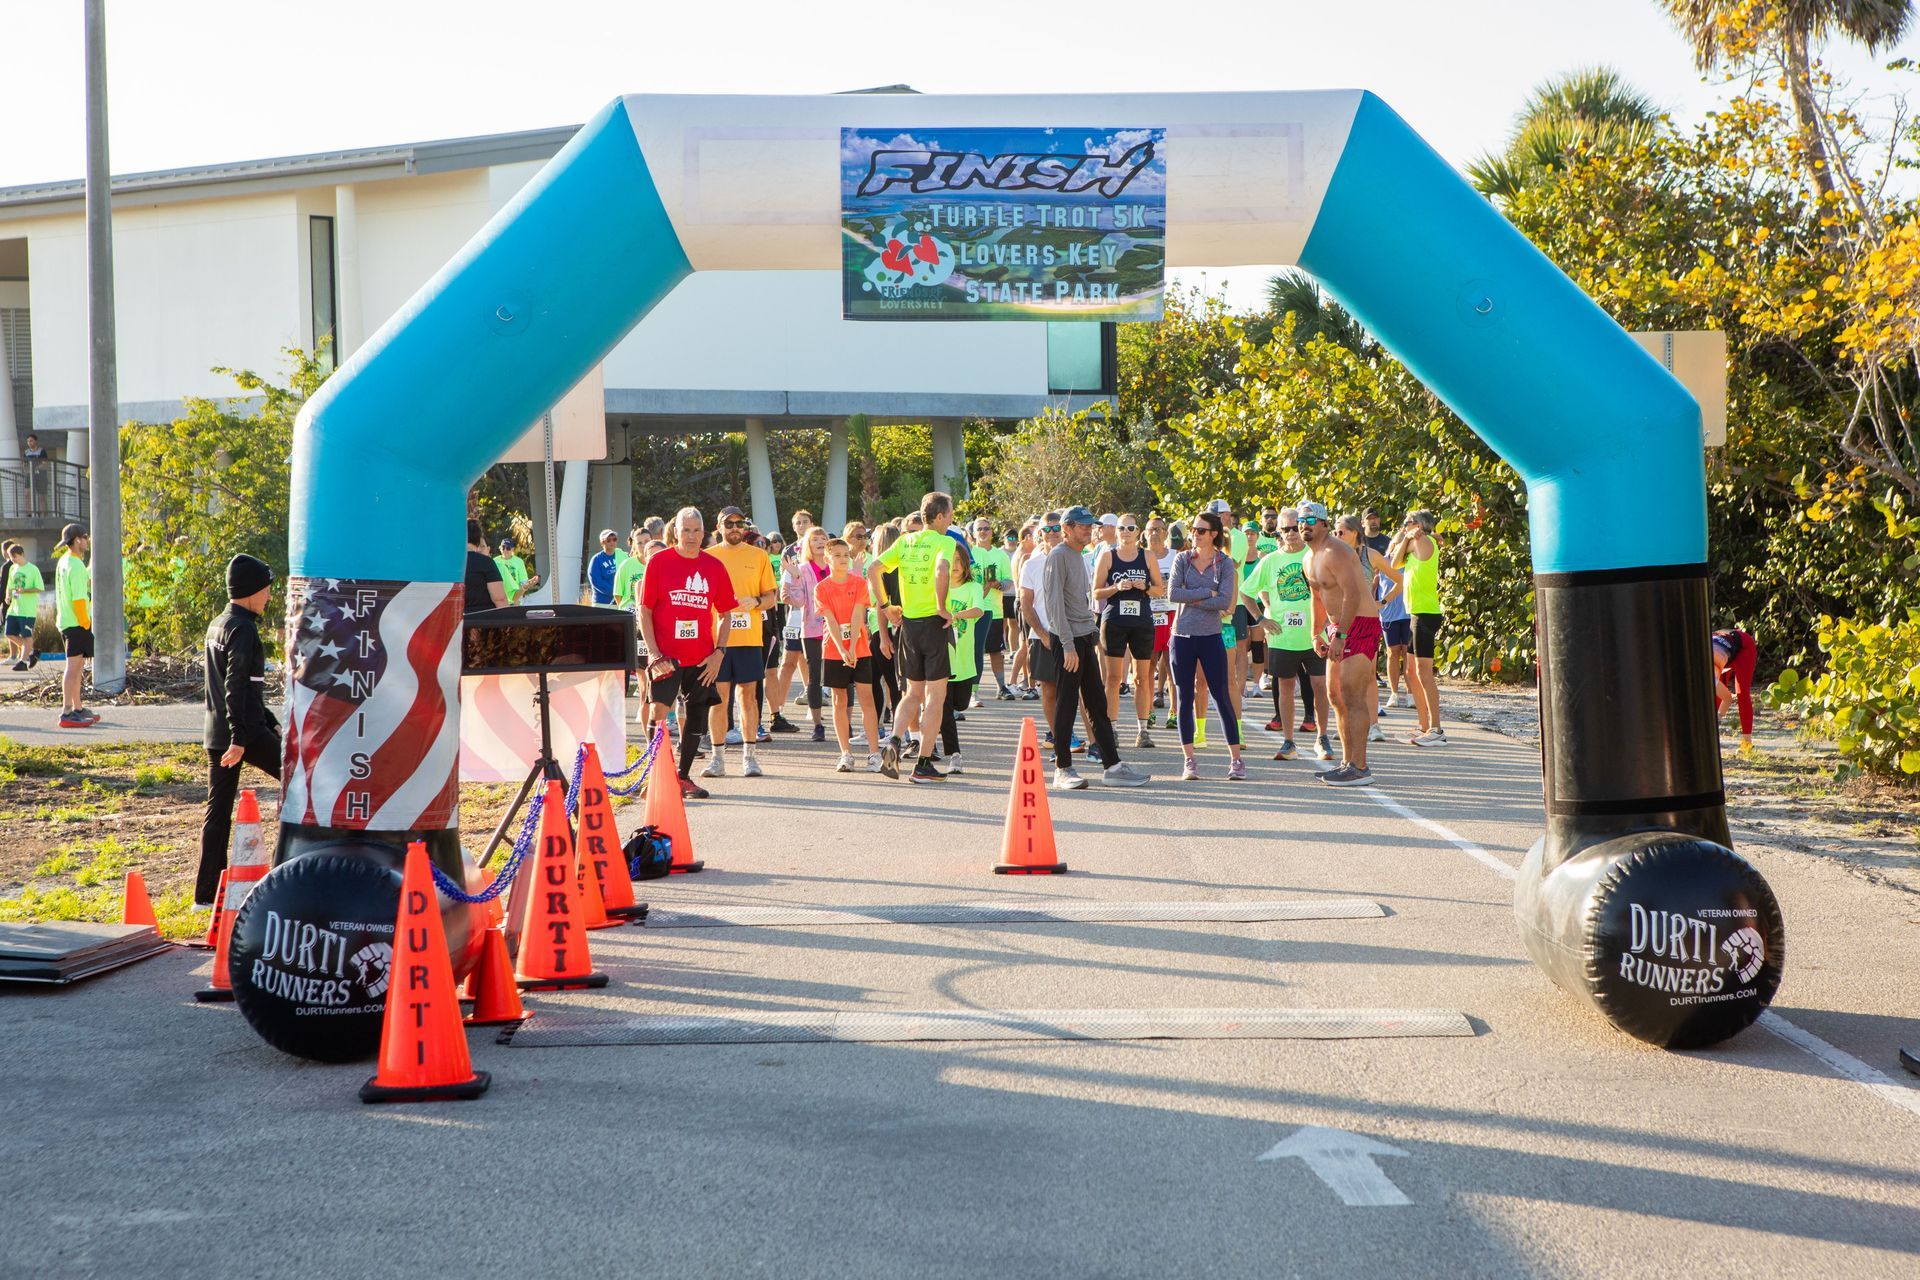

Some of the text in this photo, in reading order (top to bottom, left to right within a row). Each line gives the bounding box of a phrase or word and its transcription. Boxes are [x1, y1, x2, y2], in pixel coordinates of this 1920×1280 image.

[856, 140, 1156, 199] FINISH
[929, 204, 1147, 228] TURTLE TROT 5K
[960, 243, 1118, 266] LOVERS KEY
[965, 280, 1120, 305] STATE PARK
[669, 591, 708, 605] WATUPPA
[680, 629, 695, 638] 895
[731, 620, 747, 628] 263
[1288, 618, 1302, 626] 260
[346, 590, 377, 820] FINISH
[1022, 747, 1036, 853] DURTI
[544, 836, 570, 972] DURTI
[1697, 909, 1758, 918] VETERAN OWNED
[329, 921, 395, 933] VETERAN OWNED
[1630, 903, 1717, 965] DURTI
[261, 910, 348, 978] DURTI
[251, 958, 351, 1006] RUNNERS
[407, 891, 430, 1065] DURTI
[1620, 952, 1724, 994] RUNNERS
